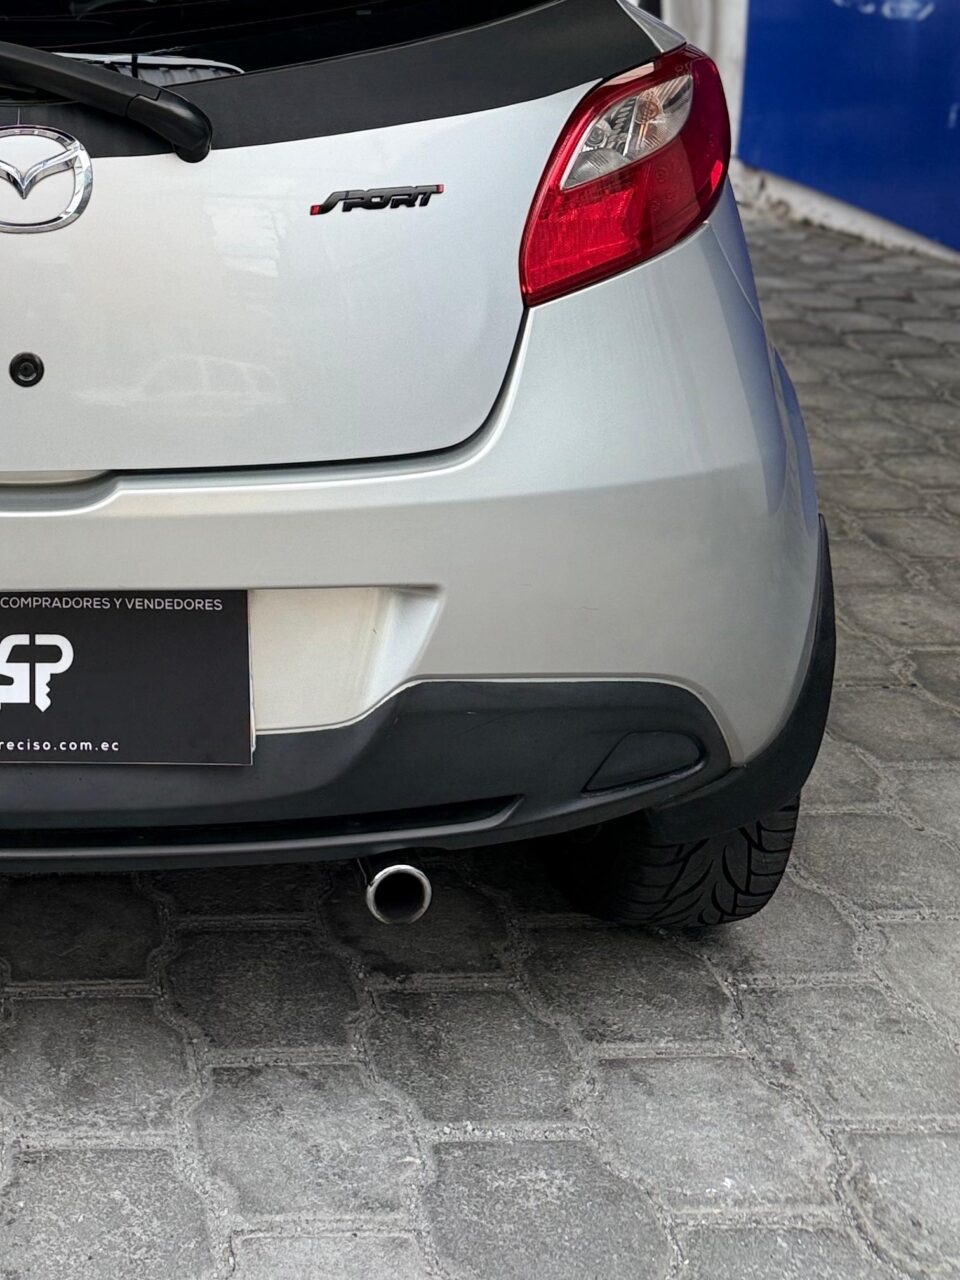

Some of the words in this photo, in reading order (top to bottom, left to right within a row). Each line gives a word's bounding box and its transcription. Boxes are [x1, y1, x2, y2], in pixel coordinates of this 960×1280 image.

[310, 184, 444, 216] SPORT
[0, 596, 111, 609] COMPRADORES
[113, 597, 124, 609] Y
[124, 597, 223, 611] VENDEDORES
